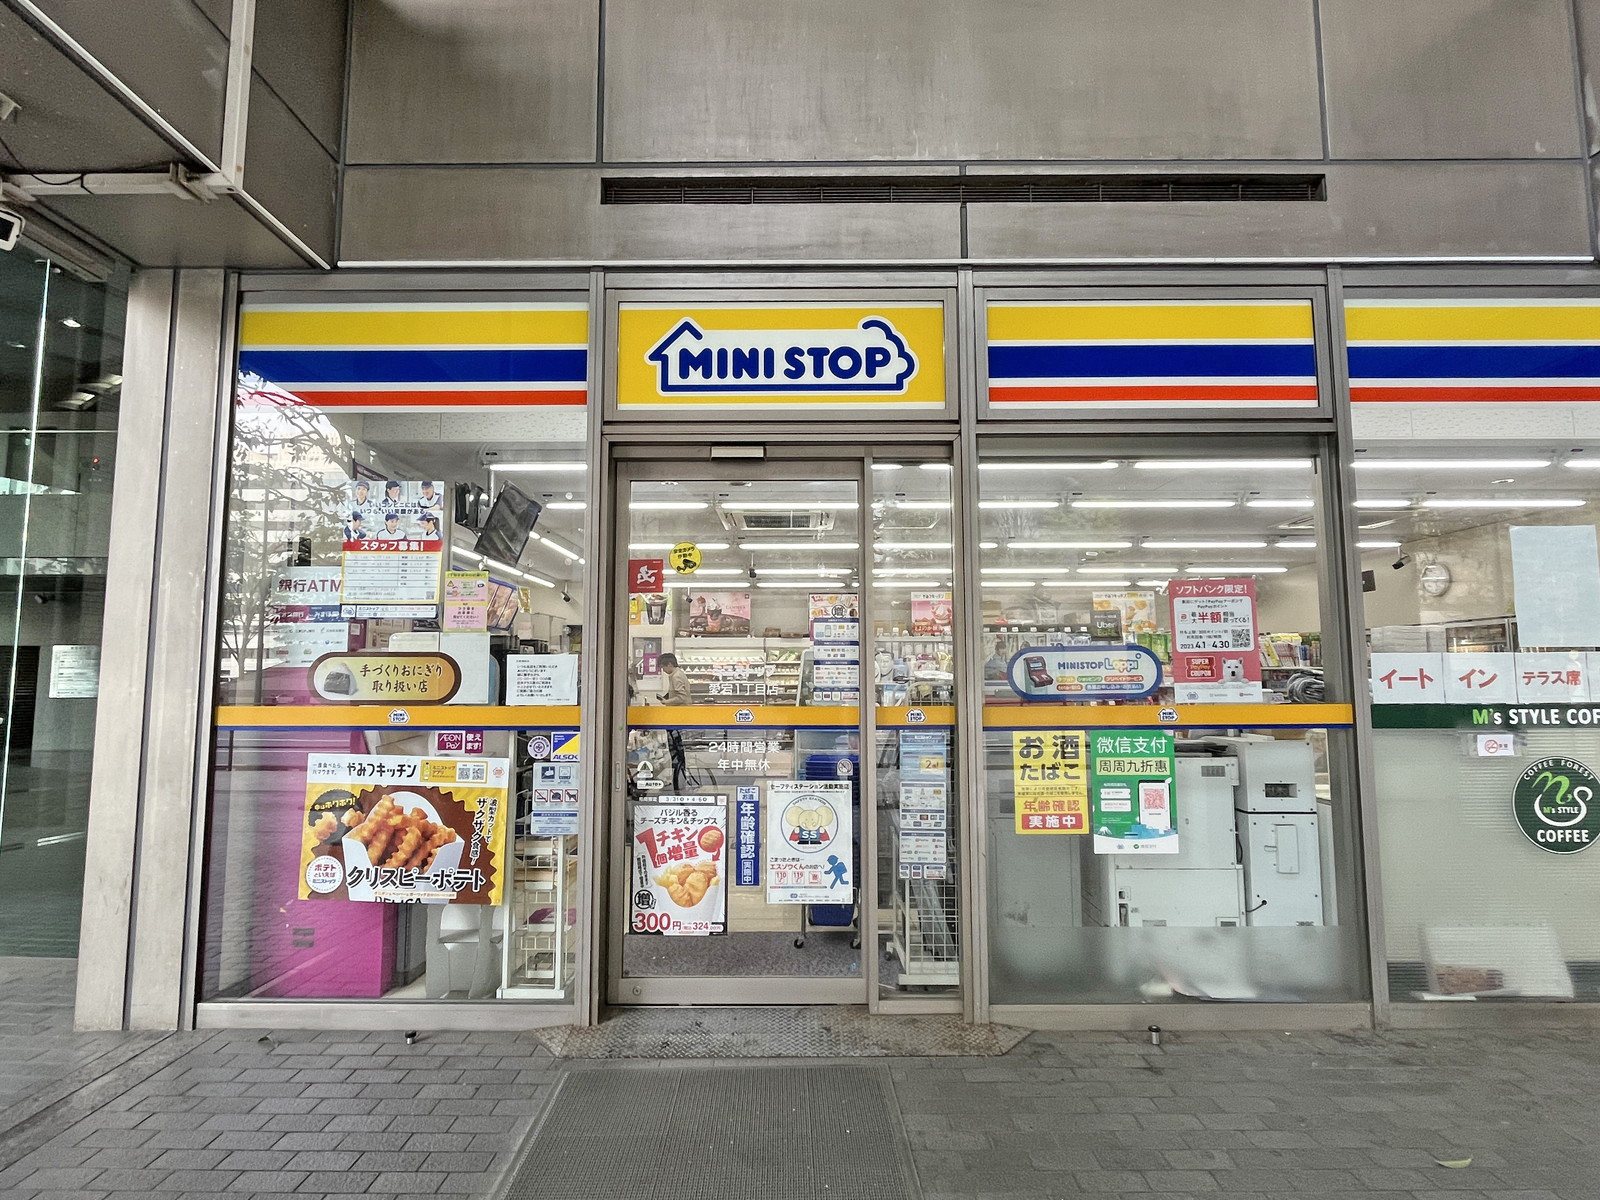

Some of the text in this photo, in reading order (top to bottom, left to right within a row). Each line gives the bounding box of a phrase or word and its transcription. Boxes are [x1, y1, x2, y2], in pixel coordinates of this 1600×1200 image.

[678, 346, 891, 380] MINI STOP
[1175, 584, 1247, 594] ソフトバンク限定!
[1198, 611, 1222, 624] 半額
[360, 664, 443, 677] 手づくりおにぎり
[1058, 661, 1104, 670] MINISTOP
[1379, 668, 1434, 689] イート
[1458, 668, 1498, 688] イン
[1522, 670, 1581, 686] テラス席
[372, 679, 429, 693] 取り扱い店
[1472, 708, 1502, 725] M's
[1508, 708, 1560, 725] STYLE
[466, 733, 481, 741] 使え
[708, 740, 780, 753] 24時間営業
[1019, 735, 1080, 759] お酒
[1096, 736, 1167, 754] 微信支付
[346, 762, 417, 778] やみつキッチン
[717, 758, 771, 771] 年中無休
[1020, 762, 1080, 780] たばこ
[1099, 759, 1168, 773] 周周九折惠
[1523, 760, 1594, 780] COFFEE FOREST
[660, 808, 698, 816] バジル香る
[1023, 800, 1080, 812] 年齢確認
[640, 817, 717, 825] チーズチキン&チップス
[1028, 815, 1076, 828] 実施中
[656, 826, 698, 847] チキン
[740, 802, 756, 859] 年齢確認
[1537, 829, 1590, 843] COFFEE
[314, 863, 336, 872] ポテト
[347, 866, 485, 891] クリスピーポテト
